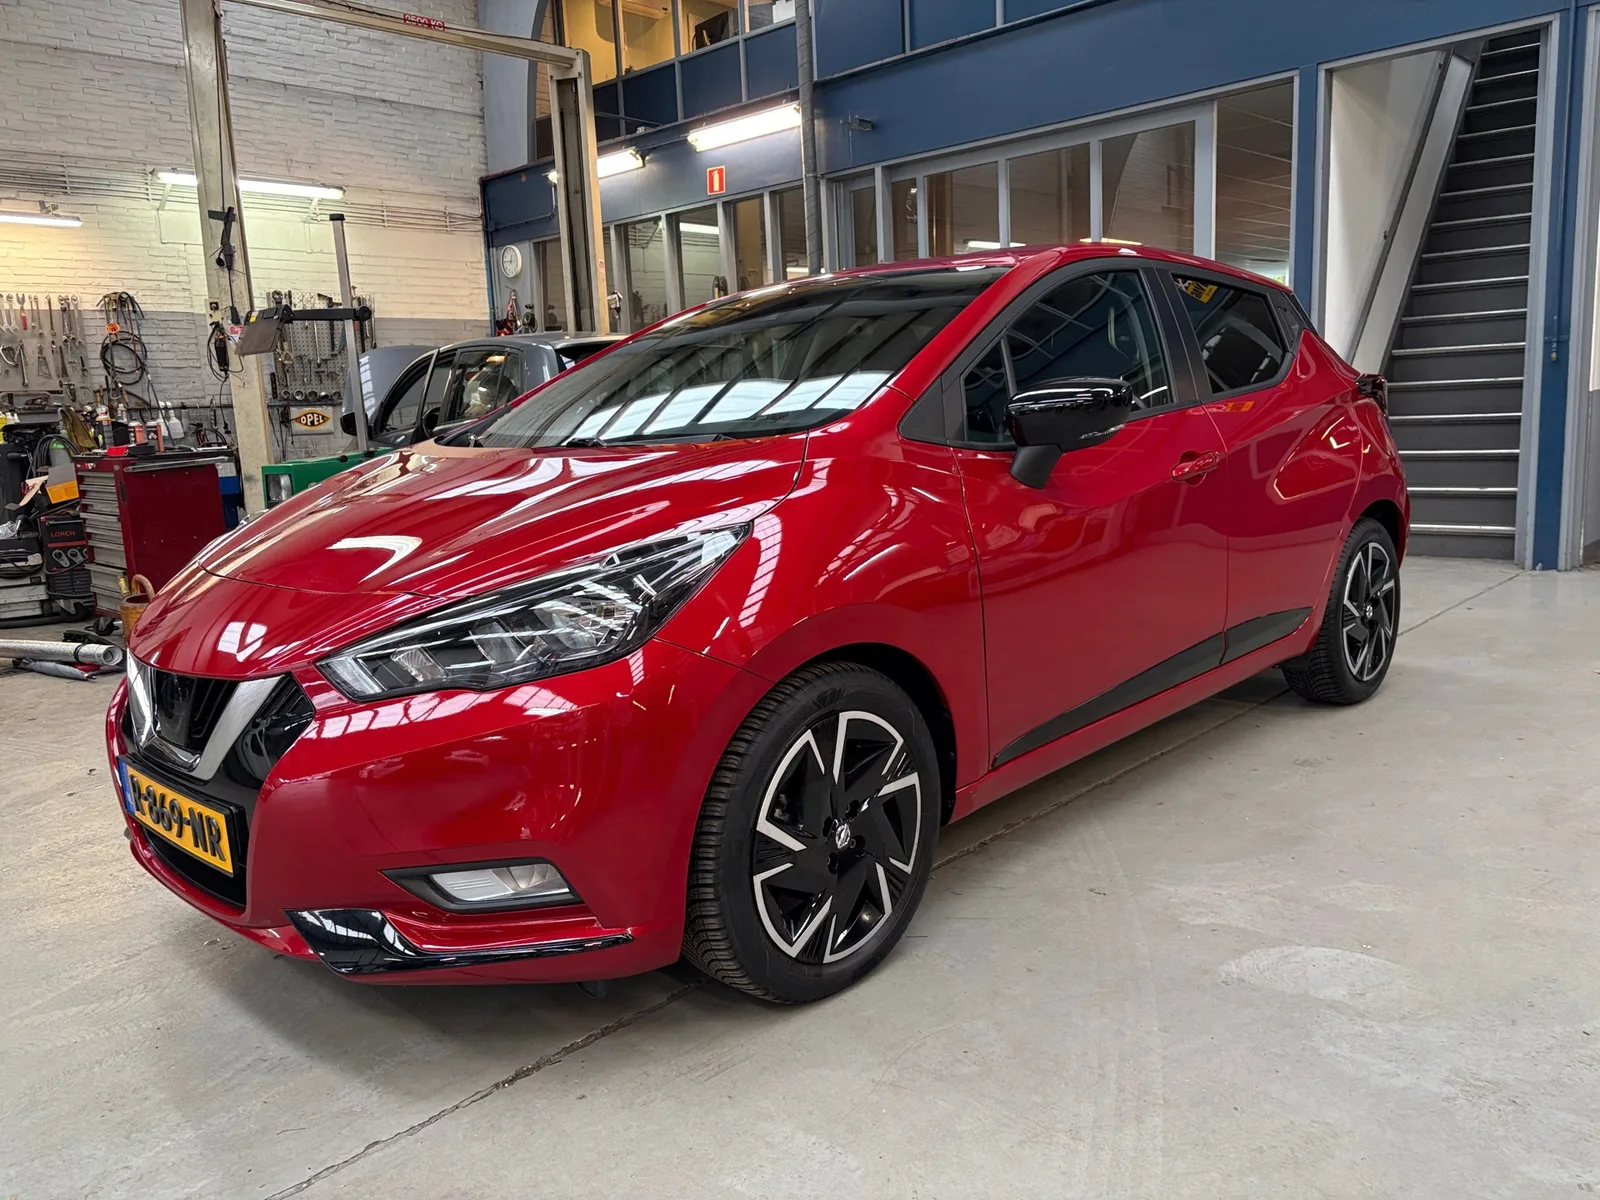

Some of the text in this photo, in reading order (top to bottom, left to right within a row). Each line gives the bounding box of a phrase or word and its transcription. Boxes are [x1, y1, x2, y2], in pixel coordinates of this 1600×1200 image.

[404, 14, 445, 31] 2500 KG
[300, 413, 324, 426] OPEL
[50, 530, 76, 538] LORCH
[129, 773, 226, 862] R-869-NR
